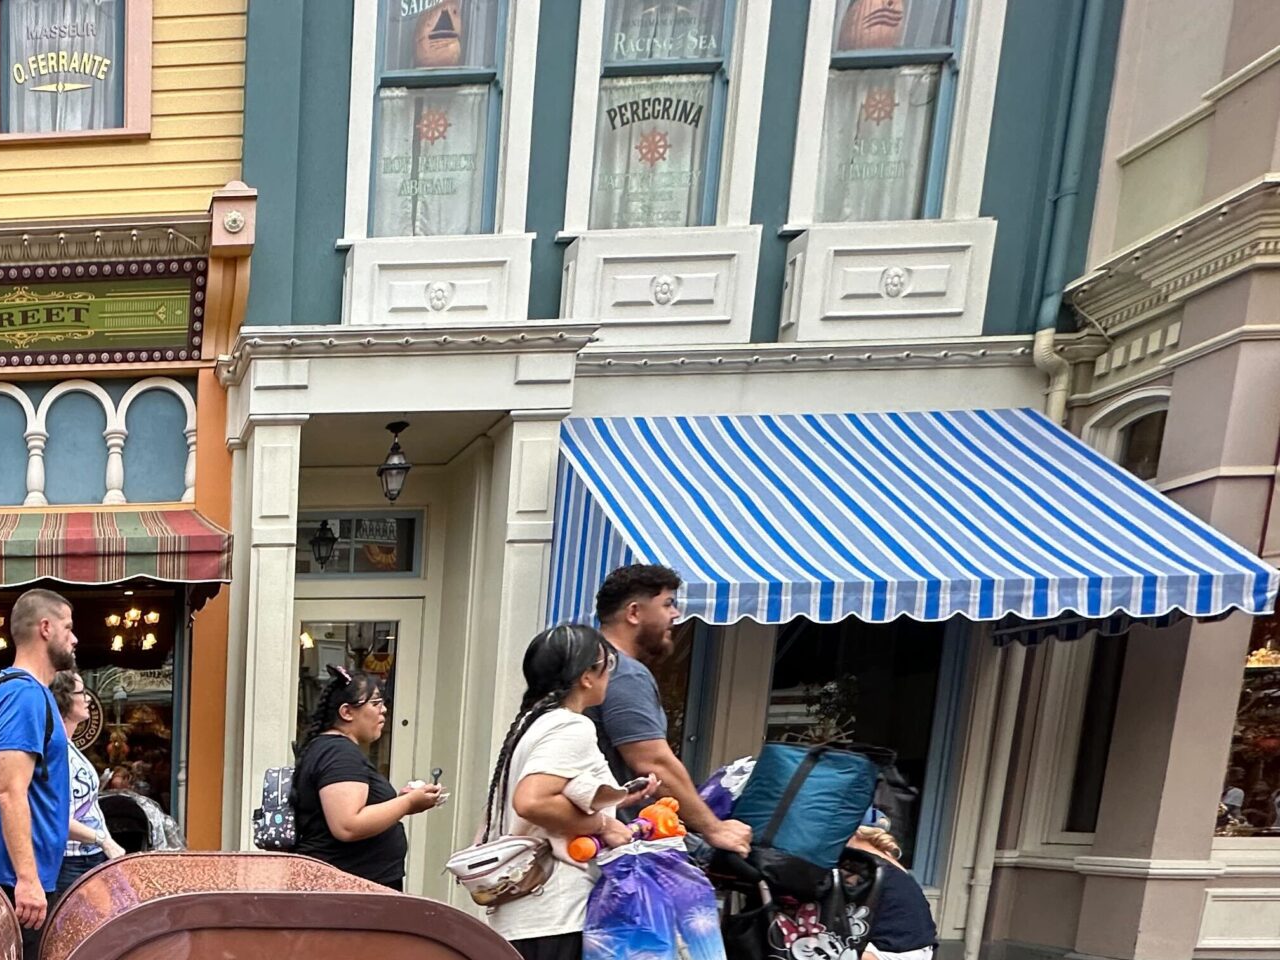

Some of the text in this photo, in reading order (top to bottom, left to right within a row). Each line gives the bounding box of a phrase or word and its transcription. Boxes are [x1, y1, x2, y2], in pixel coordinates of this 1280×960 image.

[27, 23, 97, 40] MASSEUR
[613, 31, 673, 56] RACING
[687, 29, 717, 50] SEA
[13, 50, 111, 84] O. FERRANTE
[606, 97, 704, 130] PEREGRINA
[399, 177, 457, 197] ABIGAIL
[85, 709, 99, 740] COFFEE
